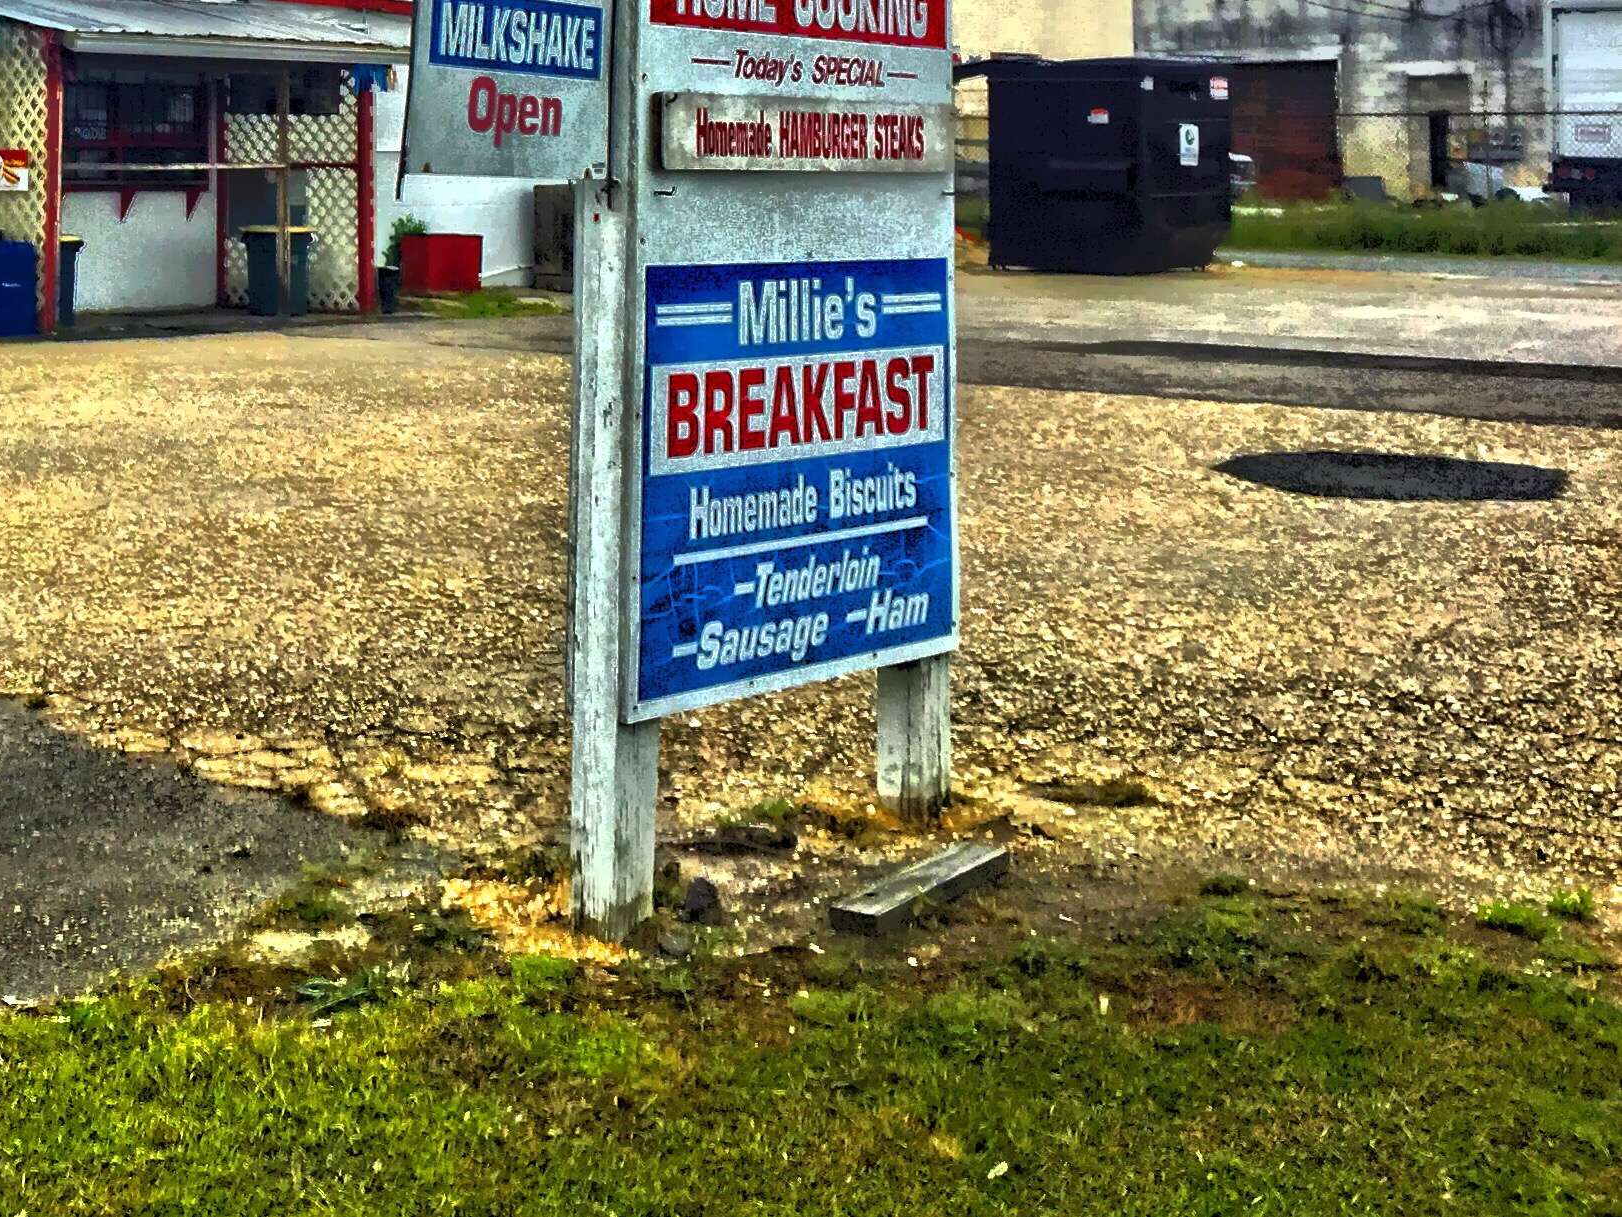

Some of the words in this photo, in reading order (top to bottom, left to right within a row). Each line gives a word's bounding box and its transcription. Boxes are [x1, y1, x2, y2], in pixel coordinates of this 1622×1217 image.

[733, 48, 804, 88] Today's
[810, 54, 886, 87] SPECIAL
[467, 74, 563, 149] Open
[695, 106, 774, 159] Homemade
[778, 109, 869, 160] HAMBURGER
[873, 112, 926, 161] STEAKS
[737, 275, 878, 346] Millie's
[666, 354, 935, 459] BREAKFAST
[688, 472, 819, 540] Homemade
[828, 462, 918, 520] Biscuits
